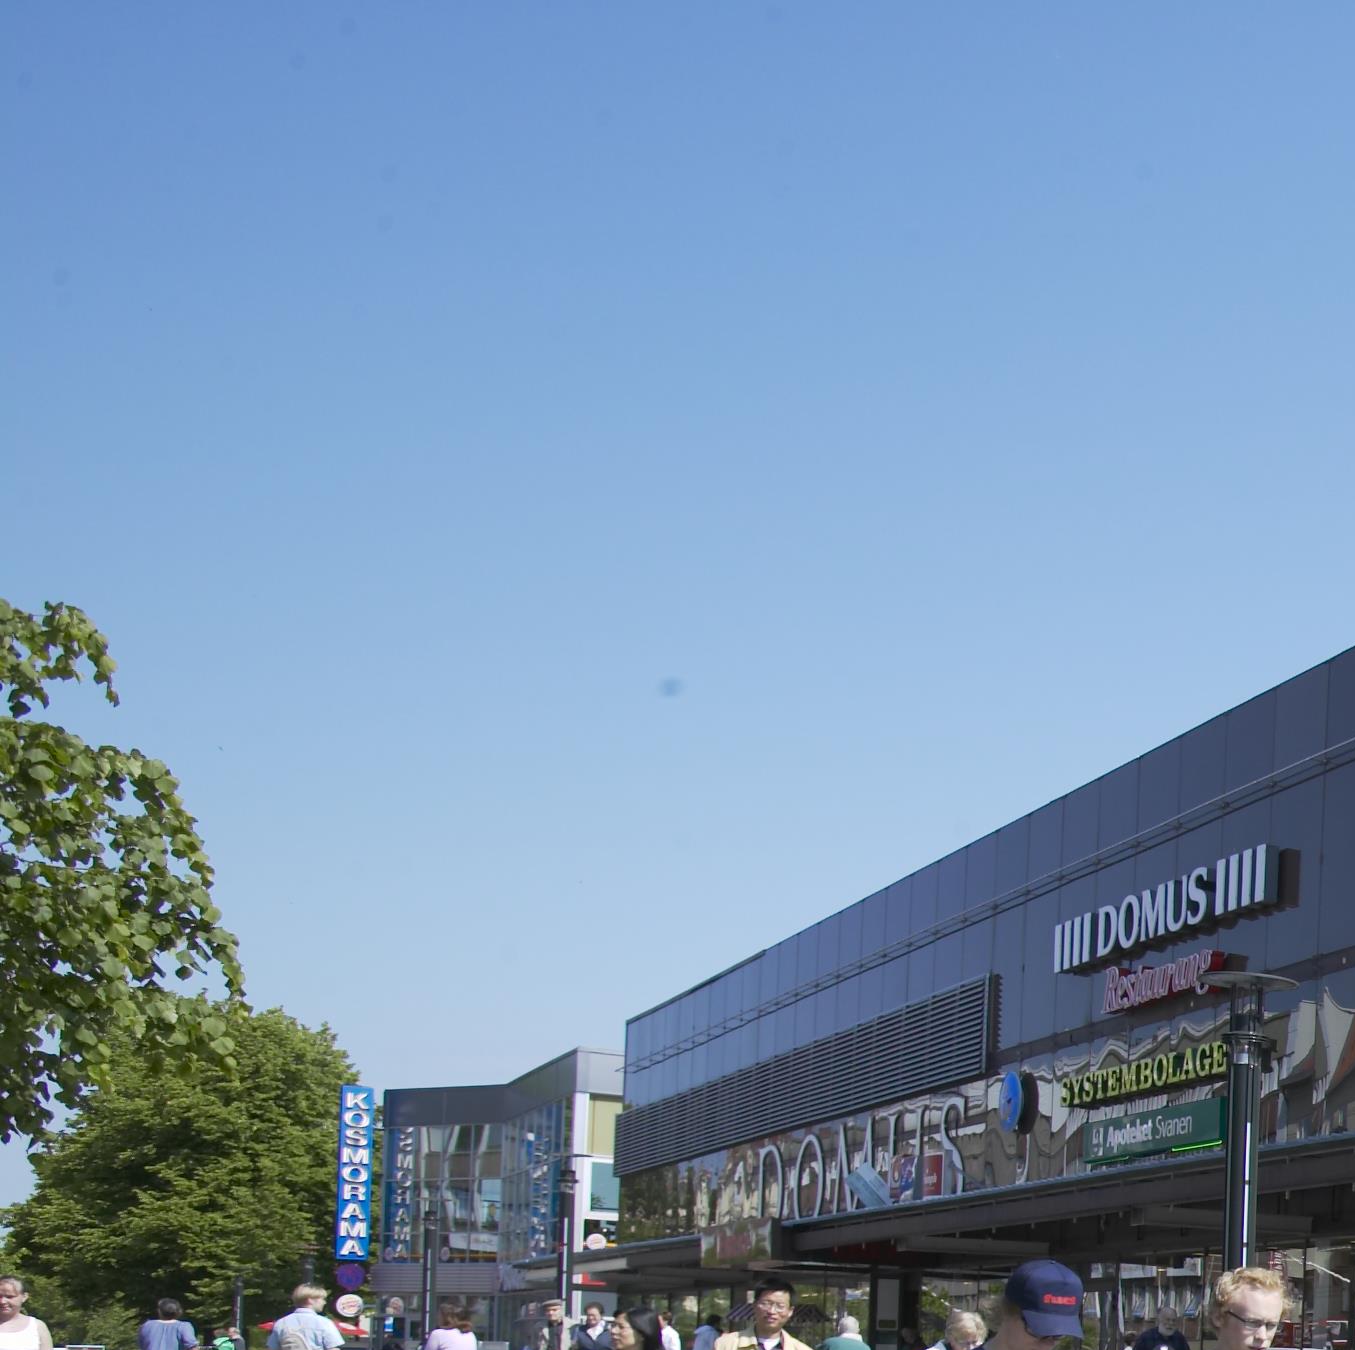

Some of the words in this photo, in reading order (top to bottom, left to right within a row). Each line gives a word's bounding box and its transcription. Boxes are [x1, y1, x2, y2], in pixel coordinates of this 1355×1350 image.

[1097, 866, 1208, 958] DOMUS
[1102, 949, 1212, 1014] Restaurang
[1060, 1041, 1228, 1107] SYSTEMBOLAGE
[1107, 1118, 1153, 1153] Apoteket
[1155, 1115, 1193, 1140] Svanen
[339, 1091, 369, 1257] KOSMORAMA
